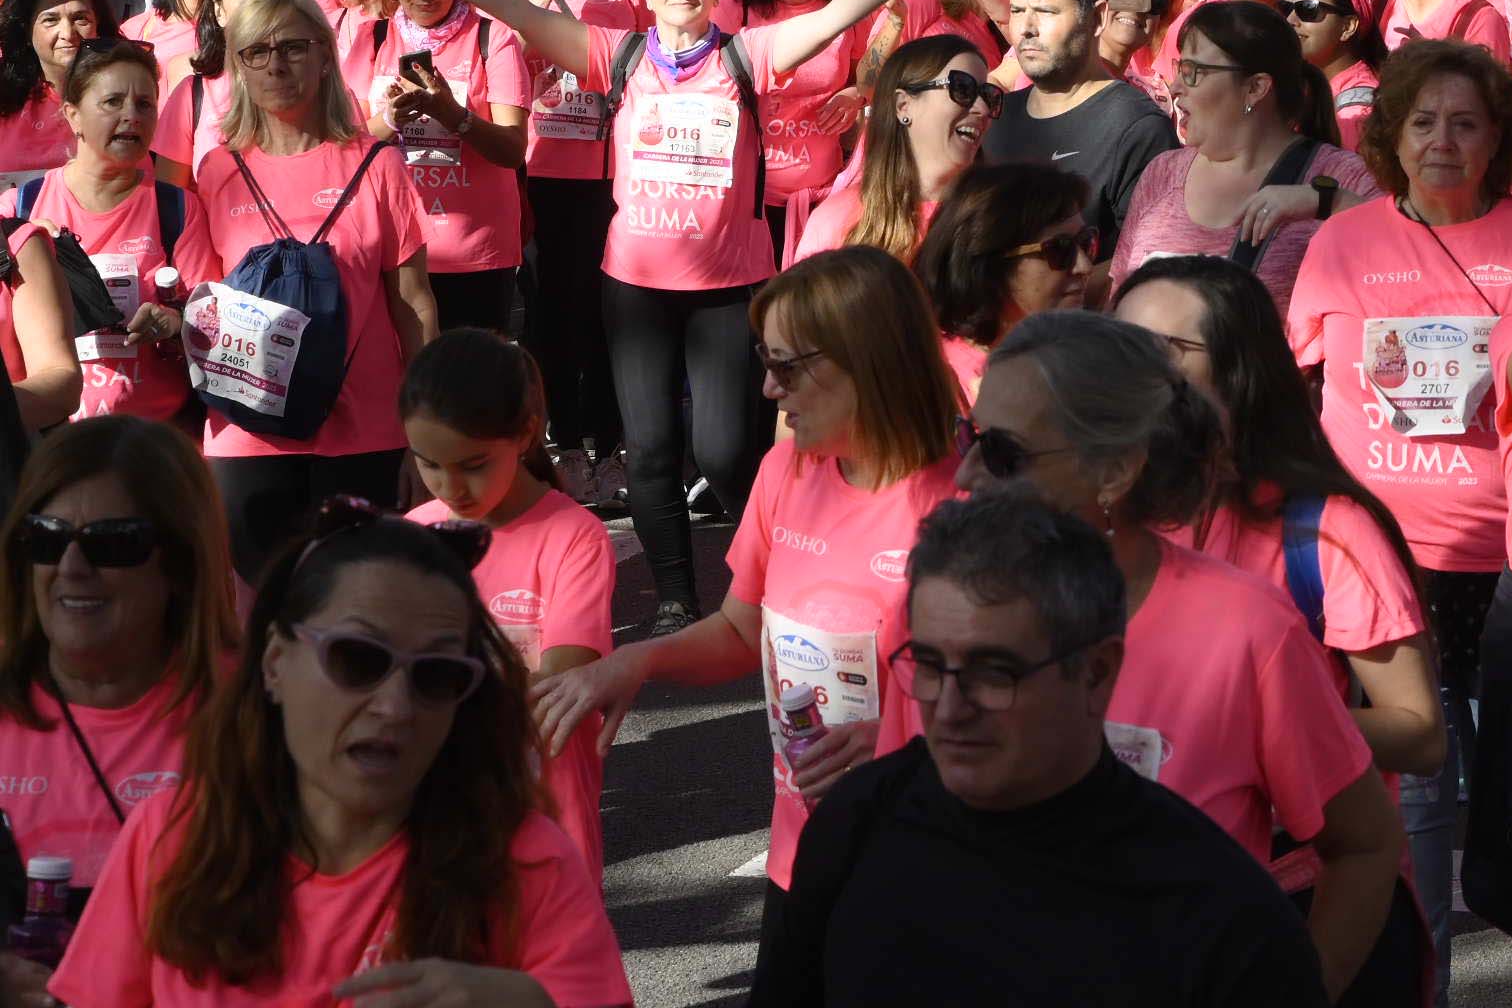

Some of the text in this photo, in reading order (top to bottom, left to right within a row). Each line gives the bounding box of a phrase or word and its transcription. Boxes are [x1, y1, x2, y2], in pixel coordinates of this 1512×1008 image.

[565, 91, 593, 105] 016
[667, 126, 700, 141] 016
[767, 119, 821, 138] ORSA
[413, 167, 471, 188] RSAL
[626, 201, 702, 231] SUMA
[1363, 269, 1421, 285] OYSHO
[221, 333, 257, 357] 016
[1409, 331, 1463, 343] ASTURIANA
[220, 352, 250, 369] 24051
[1412, 360, 1460, 377] 016
[1420, 383, 1450, 395] 2707
[1420, 399, 1431, 408] DE
[1433, 399, 1443, 408] LA
[1366, 441, 1473, 474] SUMA
[772, 526, 827, 556] OYSHO
[777, 645, 825, 668] ASTURIANA
[833, 652, 865, 664] SUMA
[779, 679, 829, 706] 06
